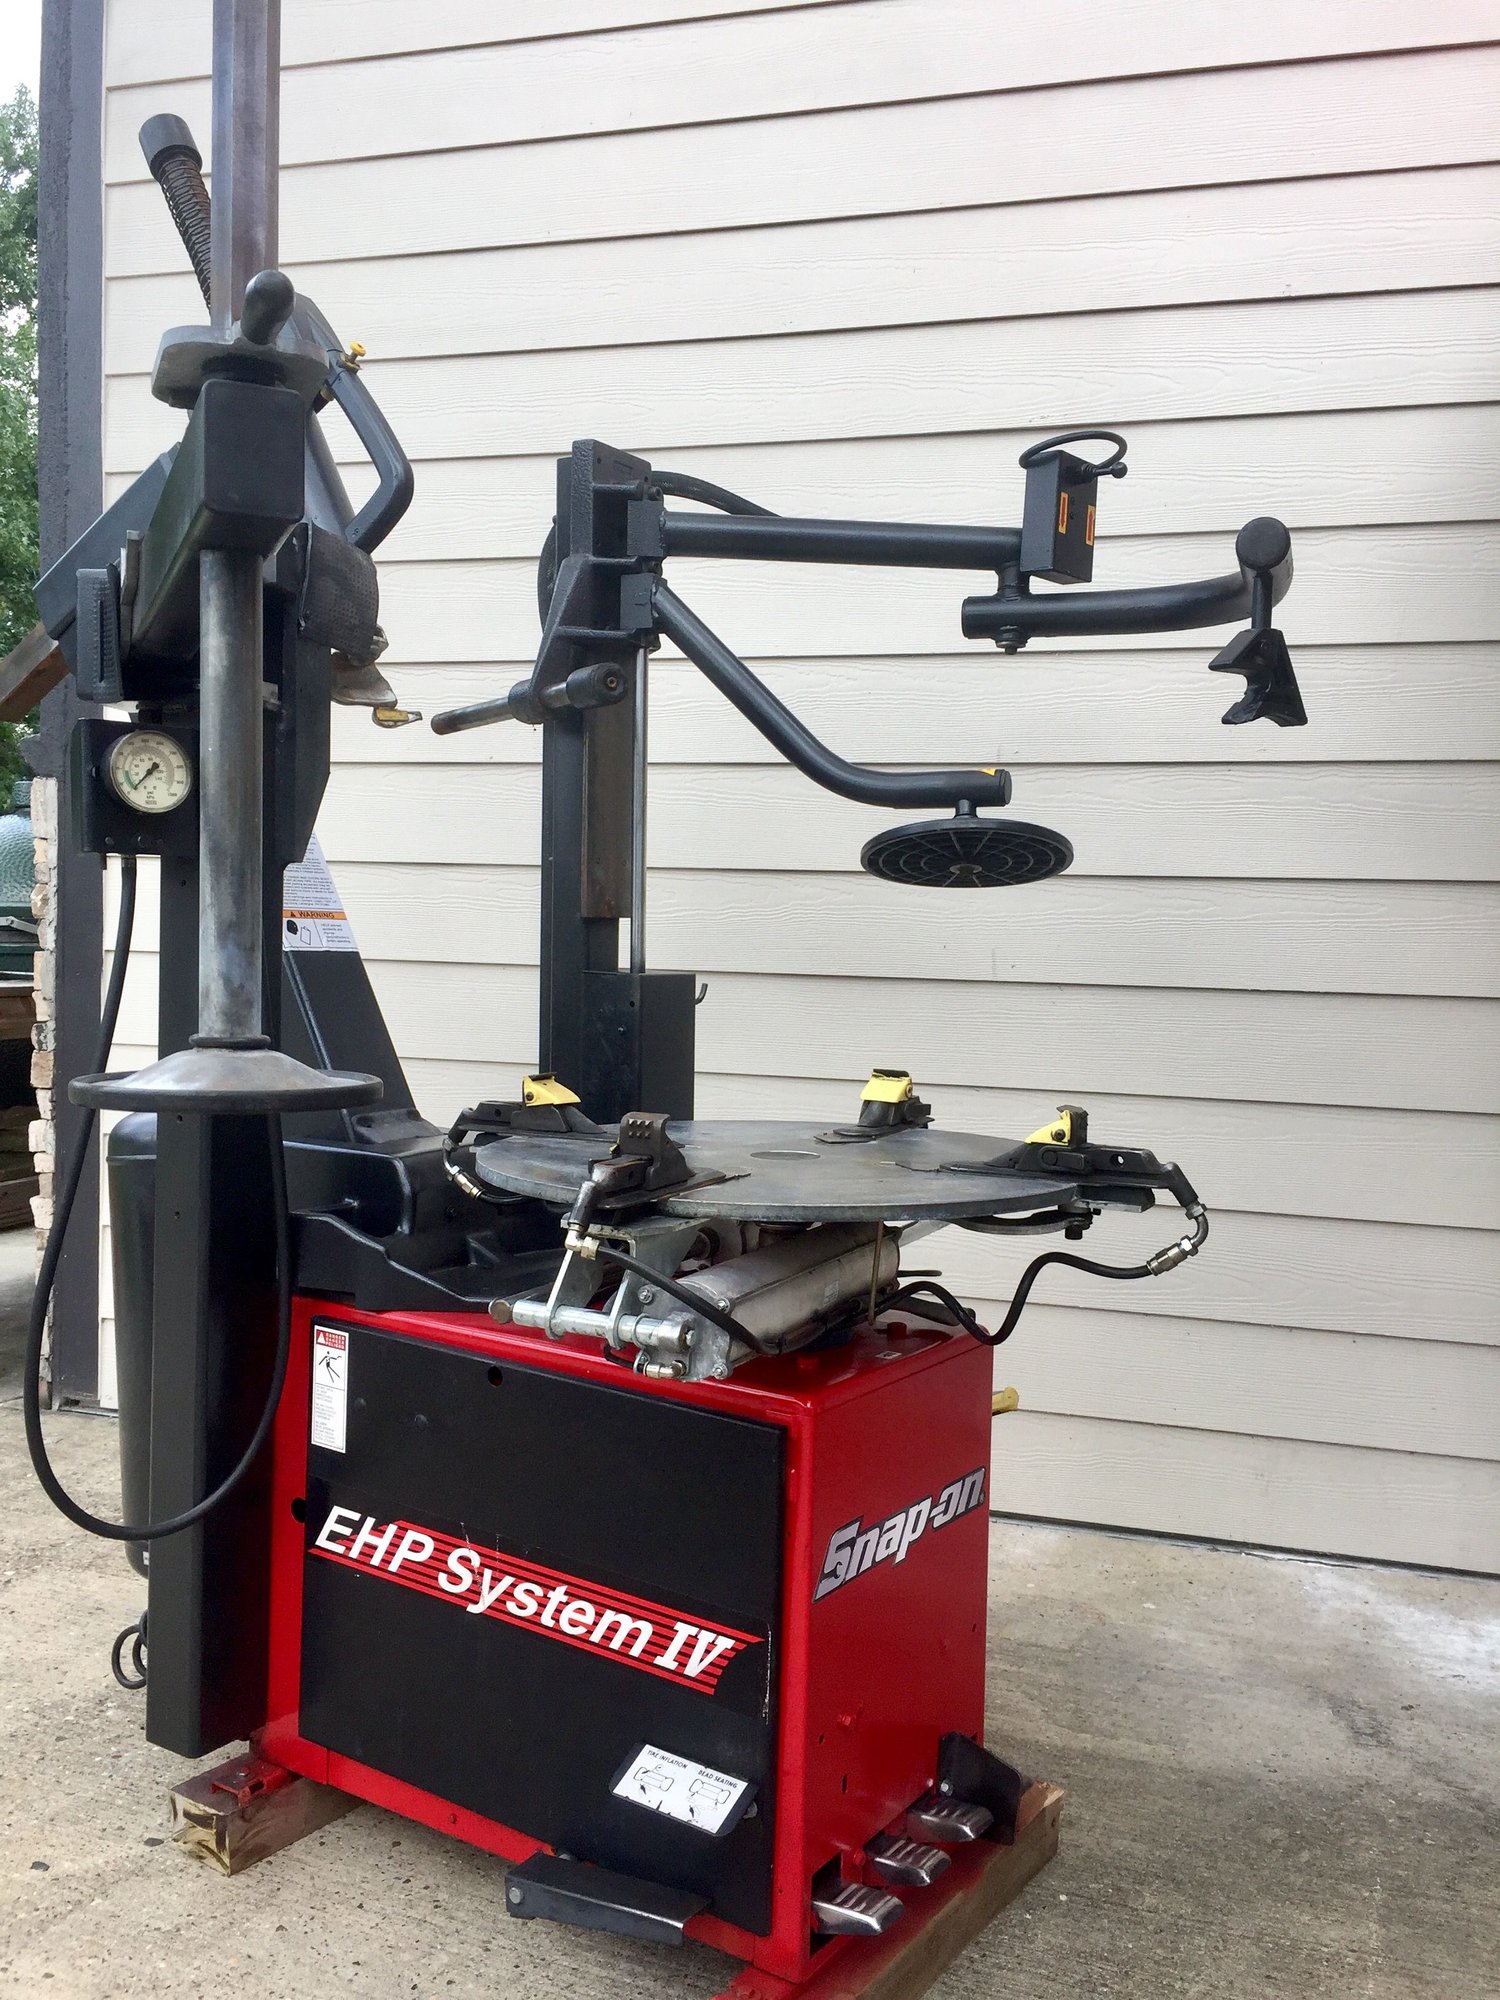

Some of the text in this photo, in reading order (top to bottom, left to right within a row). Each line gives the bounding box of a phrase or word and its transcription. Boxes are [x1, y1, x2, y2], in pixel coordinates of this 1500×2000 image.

[298, 910, 335, 919] WARNING
[813, 1466, 985, 1602] Snap-on
[314, 1505, 735, 1678] EHP System IV
[647, 1750, 688, 1769] TIRE INFLATION
[698, 1770, 738, 1789] BEAD SEATING
